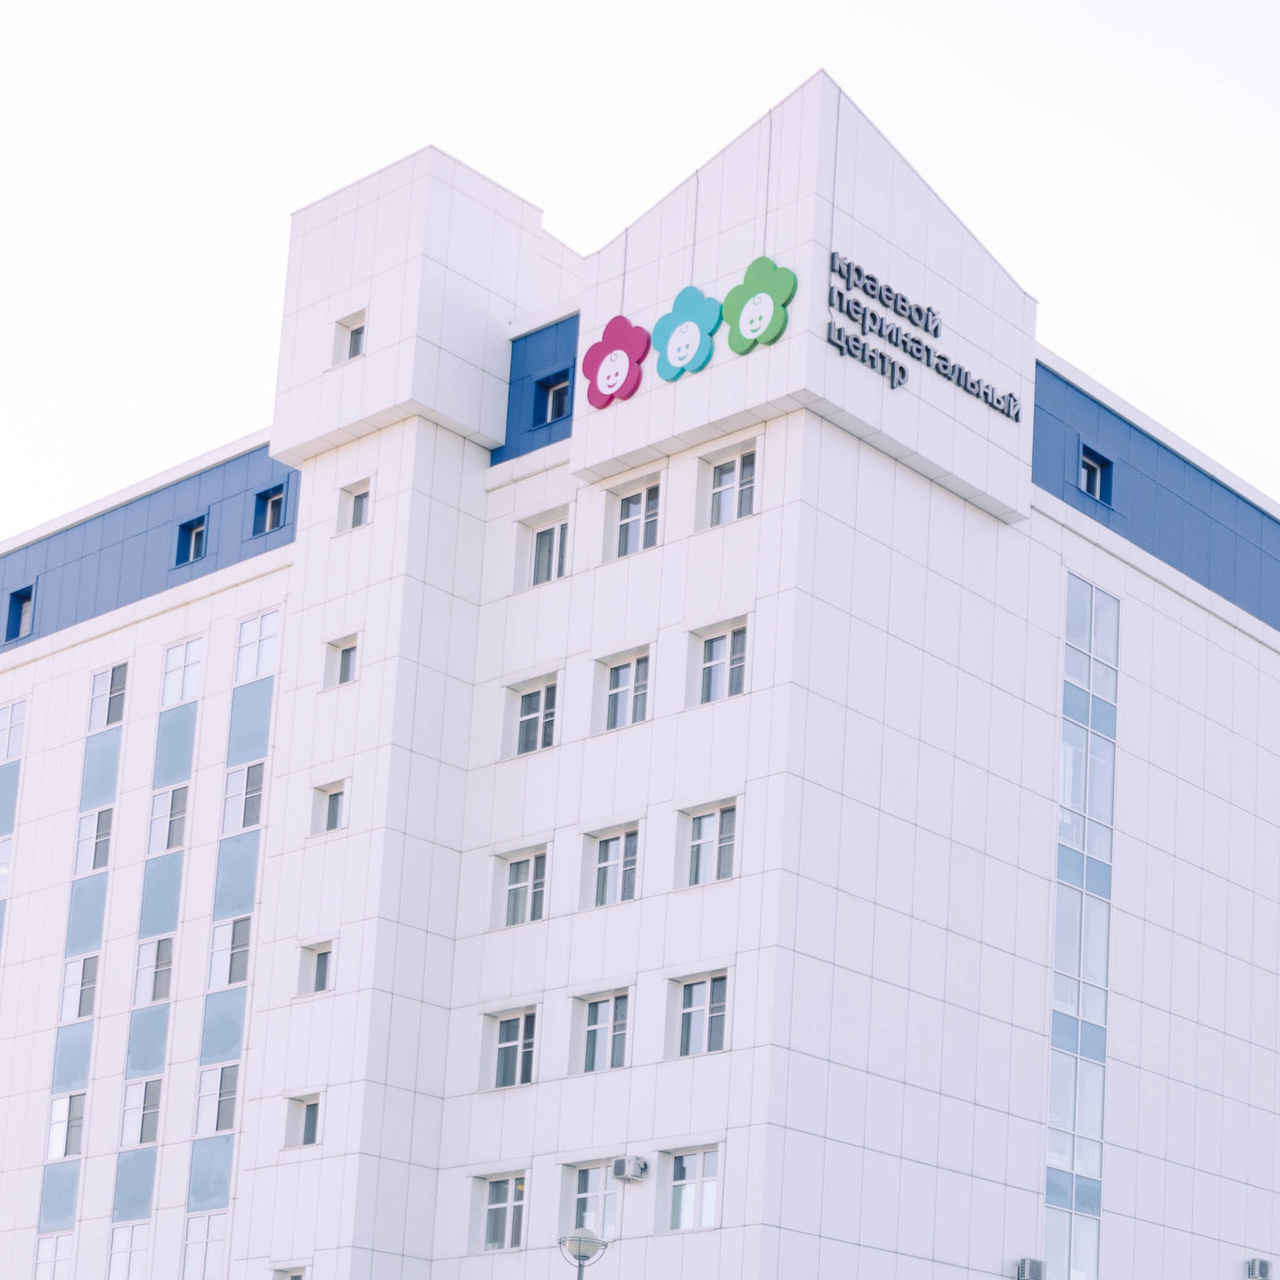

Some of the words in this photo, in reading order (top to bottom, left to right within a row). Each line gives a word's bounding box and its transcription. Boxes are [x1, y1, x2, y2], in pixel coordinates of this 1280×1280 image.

[831, 251, 942, 338] краевой
[827, 321, 909, 389] центр
[829, 286, 1022, 423] перинатальный
